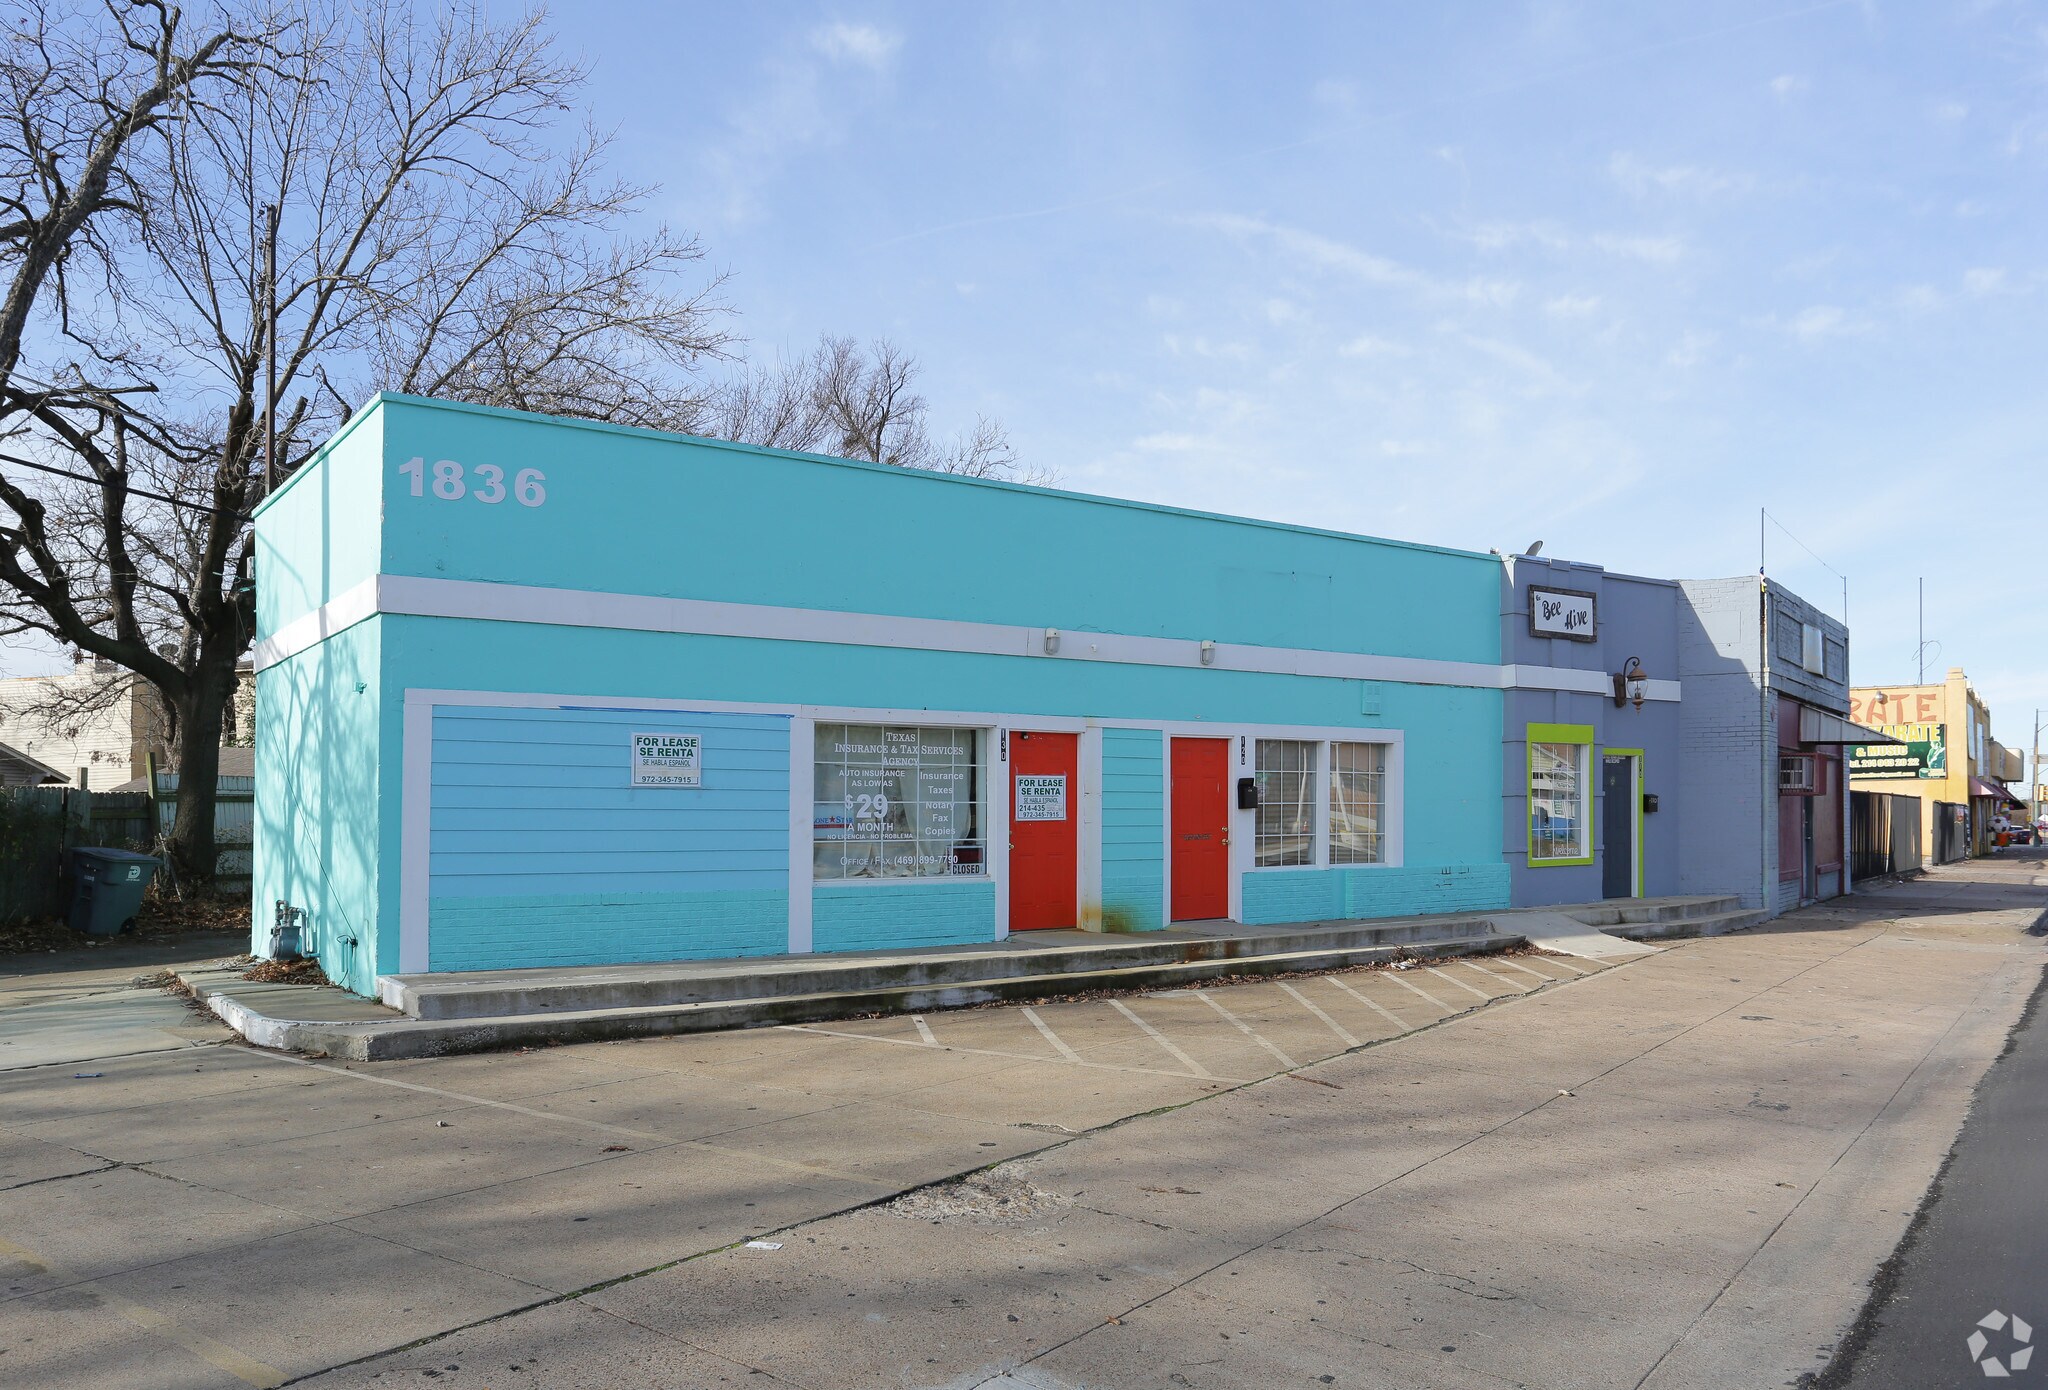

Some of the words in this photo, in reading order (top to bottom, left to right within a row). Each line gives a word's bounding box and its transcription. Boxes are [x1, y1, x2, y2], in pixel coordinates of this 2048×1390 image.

[399, 457, 546, 507] 1836
[1542, 600, 1561, 621] Bee
[1565, 609, 1588, 630] Hive
[636, 737, 659, 746] FOR
[662, 738, 697, 747] LEASE
[886, 732, 916, 742] TEXAS
[640, 747, 654, 756] SE
[657, 748, 694, 757] RENTA
[835, 743, 888, 754] INSURANCE
[891, 745, 898, 754] &
[900, 745, 919, 755] TAX
[921, 746, 964, 756] SERVICES
[1856, 748, 1866, 757] &
[882, 757, 919, 767] AGENCY
[839, 770, 860, 778] AUTO
[920, 772, 964, 781] Insurance
[864, 780, 881, 788] LOW
[883, 780, 893, 788] AS
[1019, 779, 1035, 787] FOR
[1037, 779, 1063, 787] LEASE
[928, 785, 953, 795] Taxes
[1021, 787, 1032, 795] SE
[1034, 787, 1061, 796] RENTA
[926, 801, 955, 811] Notary
[814, 816, 829, 824] ONE
[932, 813, 949, 823] Fax
[847, 823, 855, 832] A
[857, 823, 894, 832] MONTH
[925, 827, 956, 837] Copies
[840, 856, 869, 866] OFFICE
[875, 855, 892, 866] FAX
[894, 855, 917, 867] (469)
[953, 863, 980, 875] CLOSED
